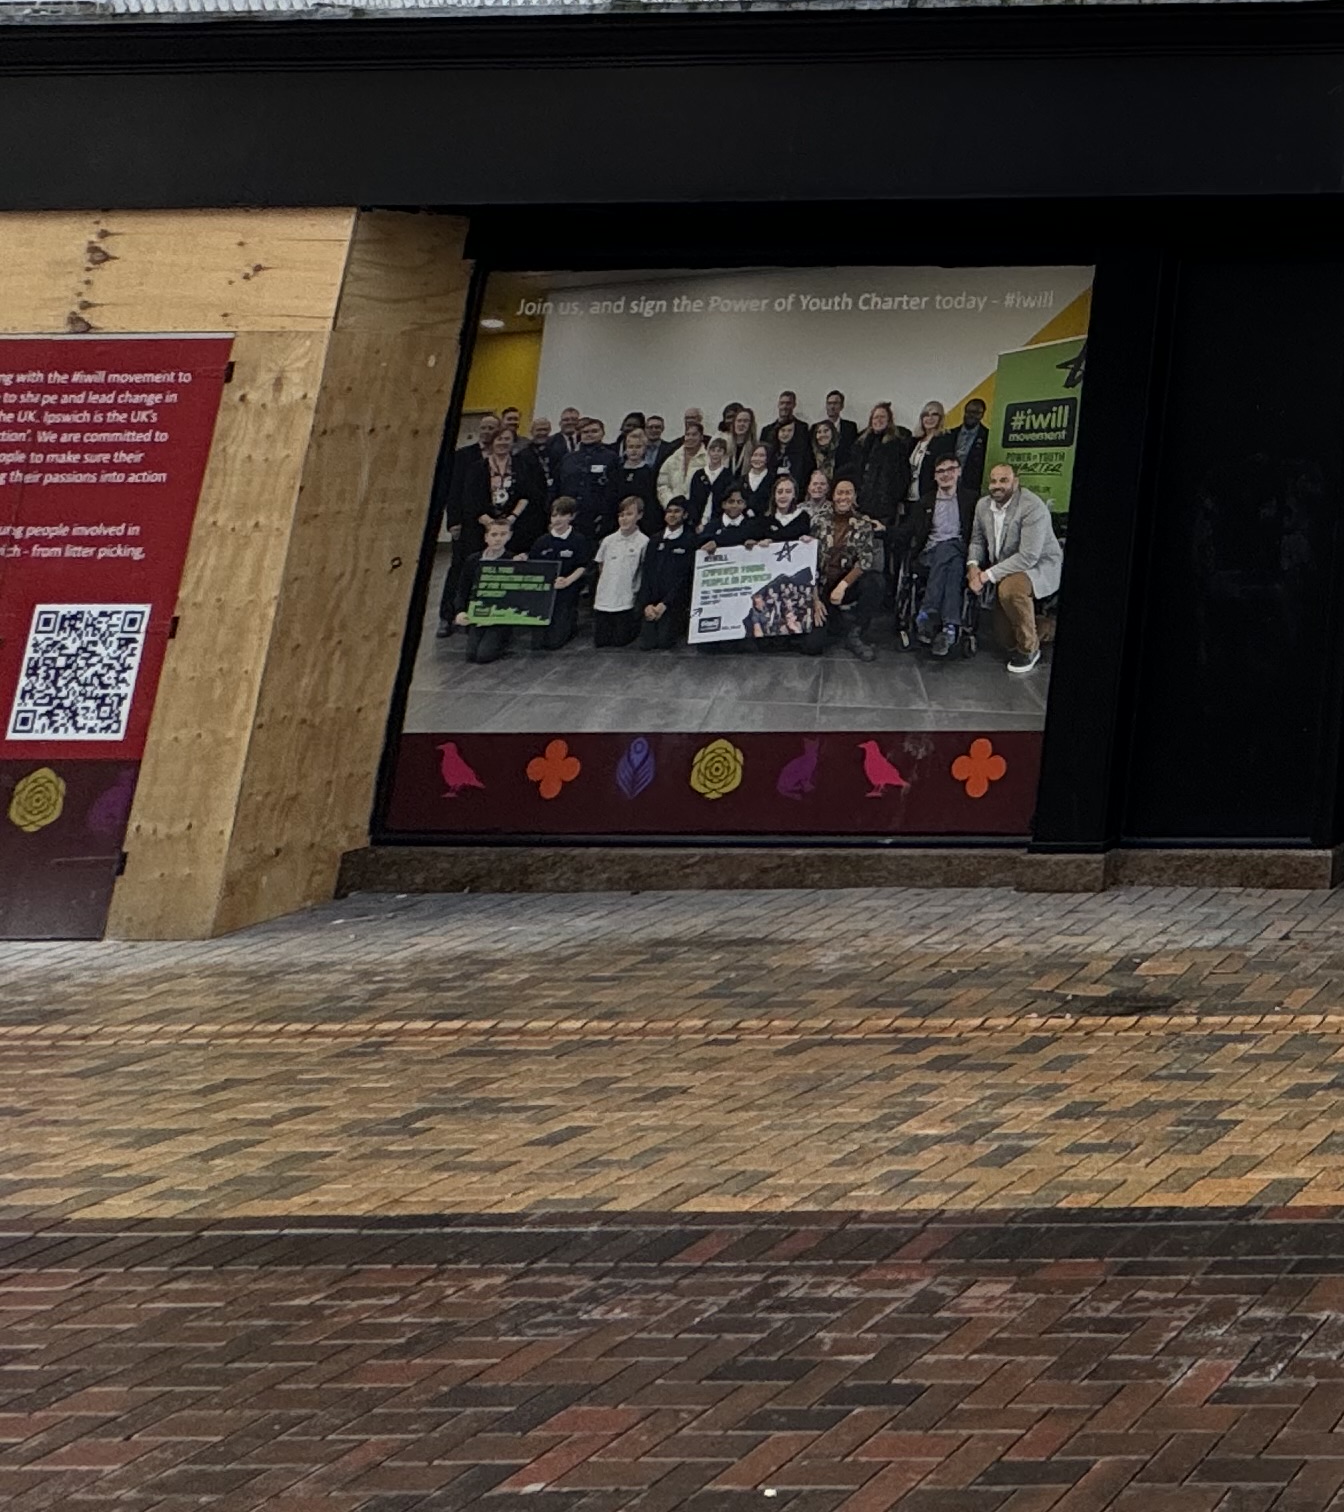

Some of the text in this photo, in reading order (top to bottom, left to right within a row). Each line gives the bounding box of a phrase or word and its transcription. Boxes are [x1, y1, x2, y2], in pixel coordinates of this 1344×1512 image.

[516, 297, 554, 316] Join
[558, 299, 585, 316] us,
[588, 296, 626, 315] and
[629, 296, 668, 318] sign
[672, 295, 704, 314] the
[707, 295, 770, 314] Power
[774, 293, 797, 312] of
[799, 292, 853, 311] Youth
[857, 292, 930, 311] Charter
[934, 291, 988, 313] today
[16, 370, 44, 383] with
[47, 371, 70, 384] the
[107, 372, 176, 384] movement
[178, 371, 193, 384] to
[3, 390, 179, 407] to shape and lead change in
[43, 411, 91, 425] Ipswich
[93, 410, 105, 423] is
[106, 410, 128, 423] the
[1010, 404, 1070, 430] #iwill
[37, 430, 58, 443] We
[60, 432, 81, 443] are
[82, 429, 153, 443] committed
[153, 431, 169, 442] to
[1008, 429, 1067, 442] movement
[29, 452, 44, 464] to
[45, 450, 81, 464] make
[82, 453, 111, 464] sure
[112, 450, 145, 464] their
[9, 470, 43, 484] their
[42, 471, 98, 486] passions
[99, 470, 126, 483] into
[126, 470, 168, 483] action
[25, 523, 70, 539] people
[71, 523, 126, 537] involved
[126, 524, 141, 537] in
[31, 544, 62, 557] from
[64, 544, 96, 557] litter
